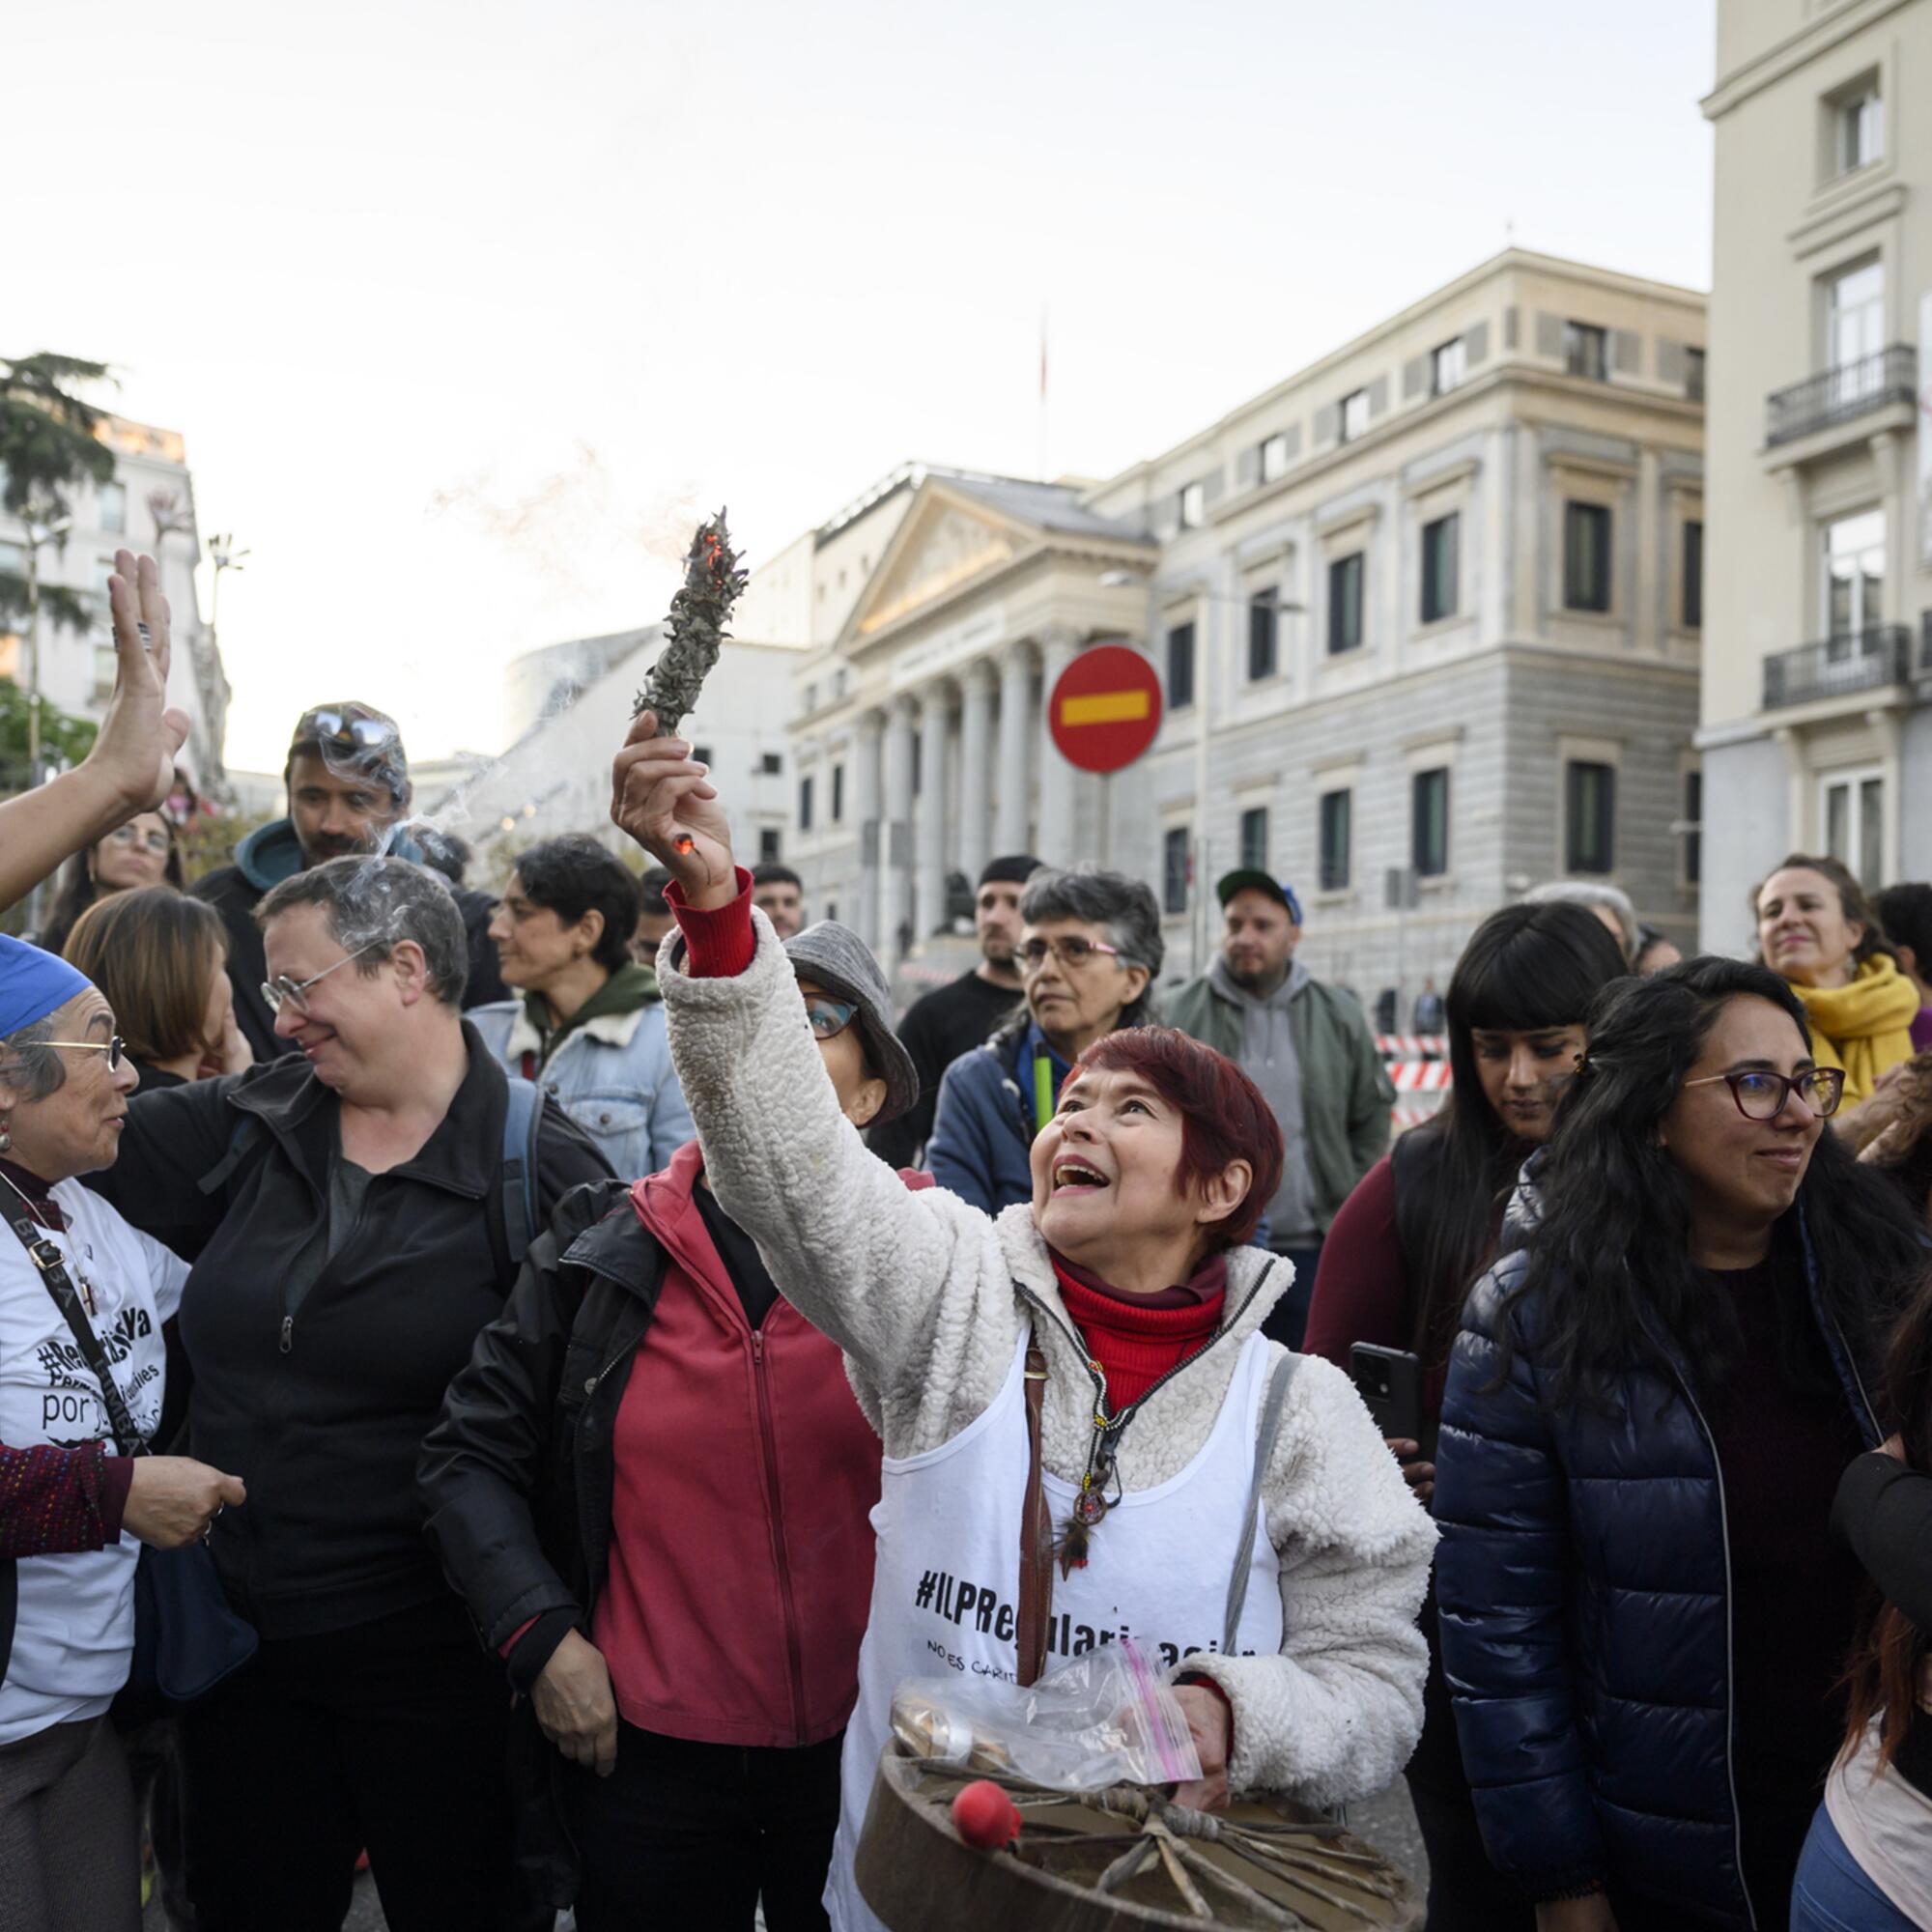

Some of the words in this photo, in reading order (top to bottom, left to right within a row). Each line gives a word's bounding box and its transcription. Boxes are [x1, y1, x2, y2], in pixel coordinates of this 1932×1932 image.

[43, 1394, 89, 1430] por
[927, 1640, 946, 1658] NO
[948, 1656, 965, 1671] ES
